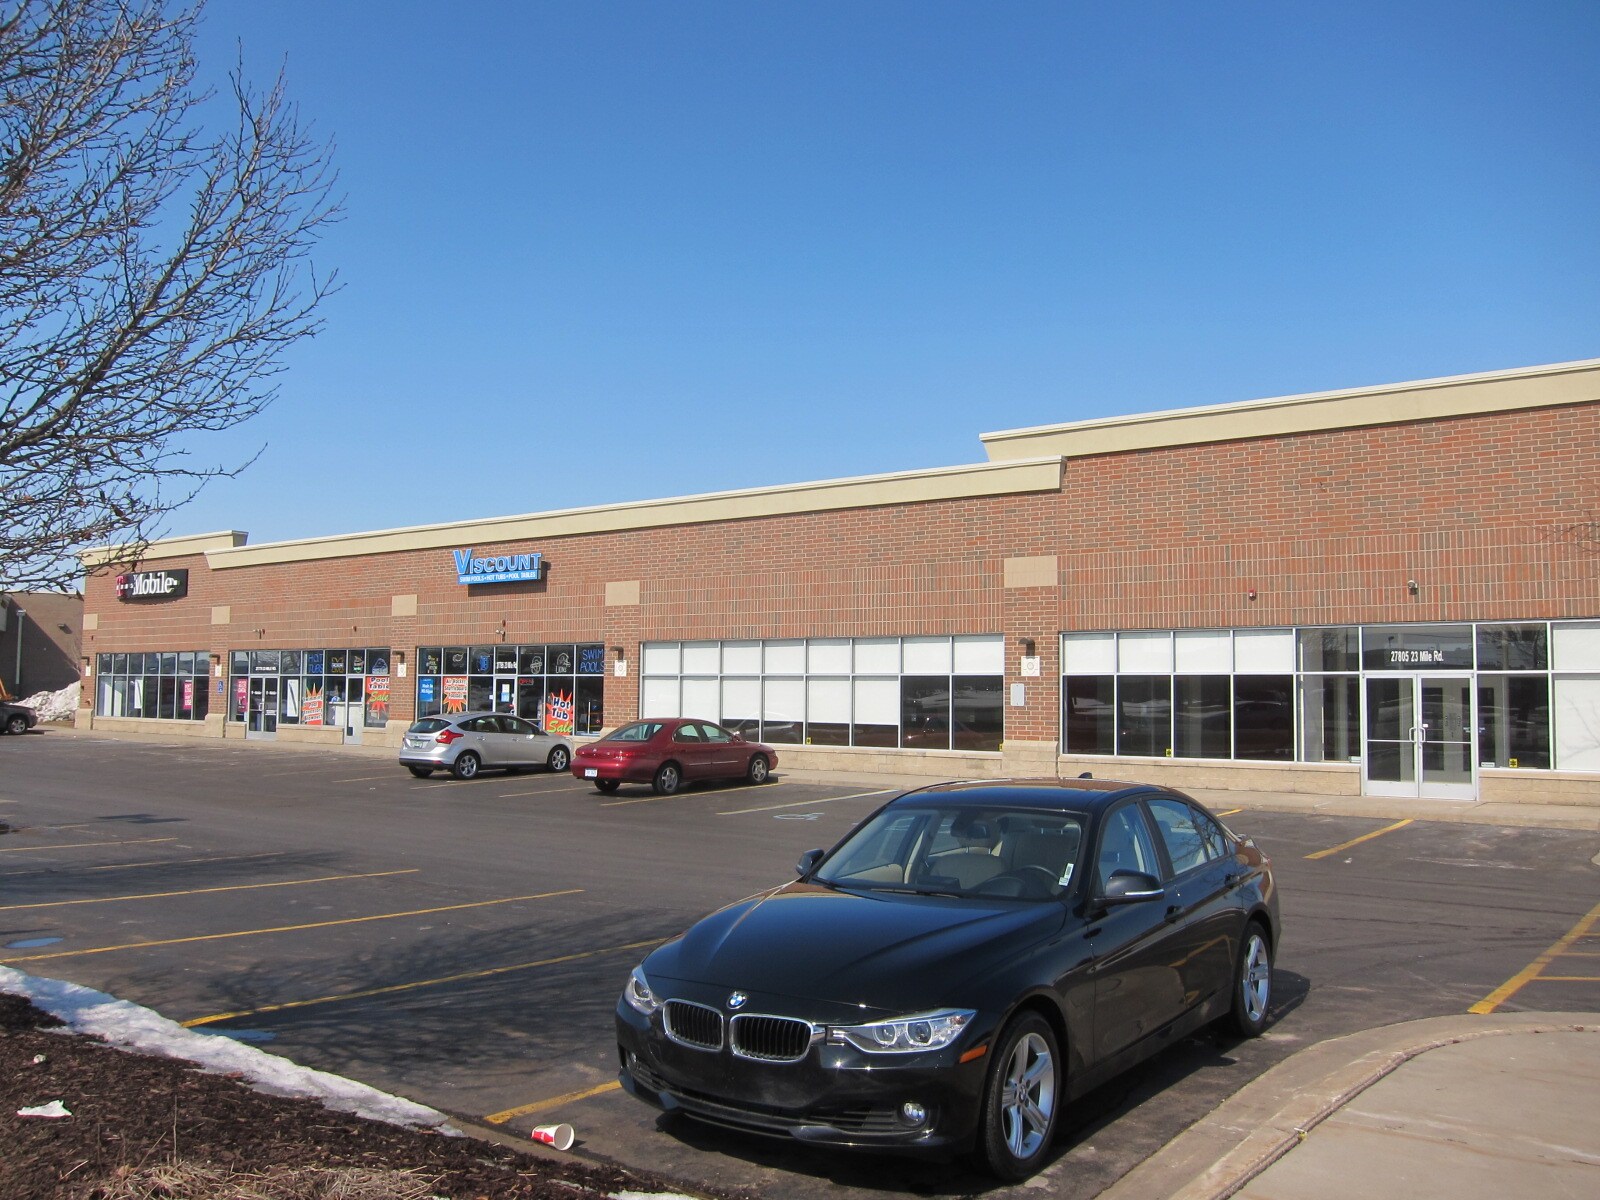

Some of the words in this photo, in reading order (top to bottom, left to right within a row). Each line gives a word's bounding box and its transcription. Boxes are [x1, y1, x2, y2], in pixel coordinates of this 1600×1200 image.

[583, 649, 604, 660] SWIM
[1390, 650, 1410, 662] 27805
[1410, 650, 1419, 662] 23
[1419, 650, 1433, 662] Mile
[580, 661, 605, 673] POOLS
[370, 676, 390, 684] Pool
[370, 691, 389, 702] Sale
[553, 697, 571, 709] Hot
[551, 709, 569, 720] Tub
[547, 720, 573, 733] Sale
